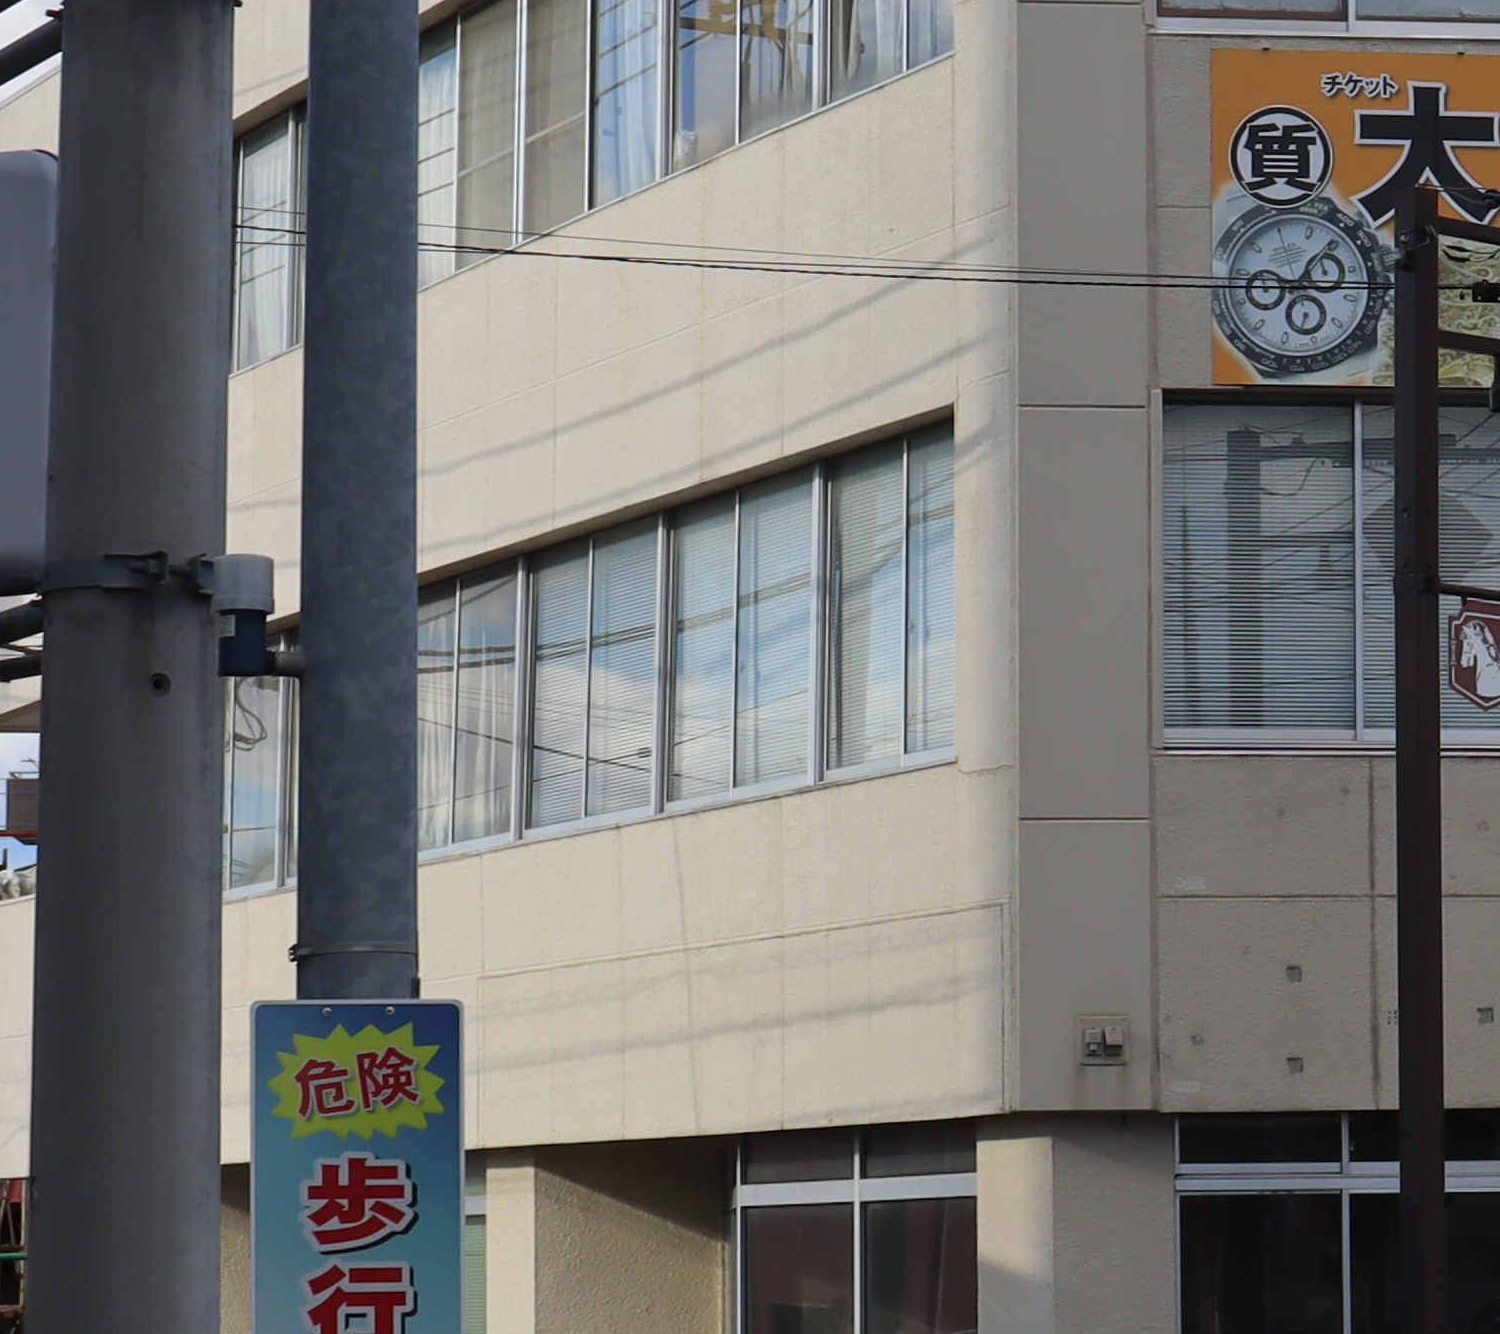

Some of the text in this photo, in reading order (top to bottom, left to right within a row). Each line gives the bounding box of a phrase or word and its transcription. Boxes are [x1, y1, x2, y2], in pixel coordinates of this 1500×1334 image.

[1320, 71, 1399, 98] チケット
[1243, 121, 1320, 194] 質
[293, 1046, 420, 1118] 危険
